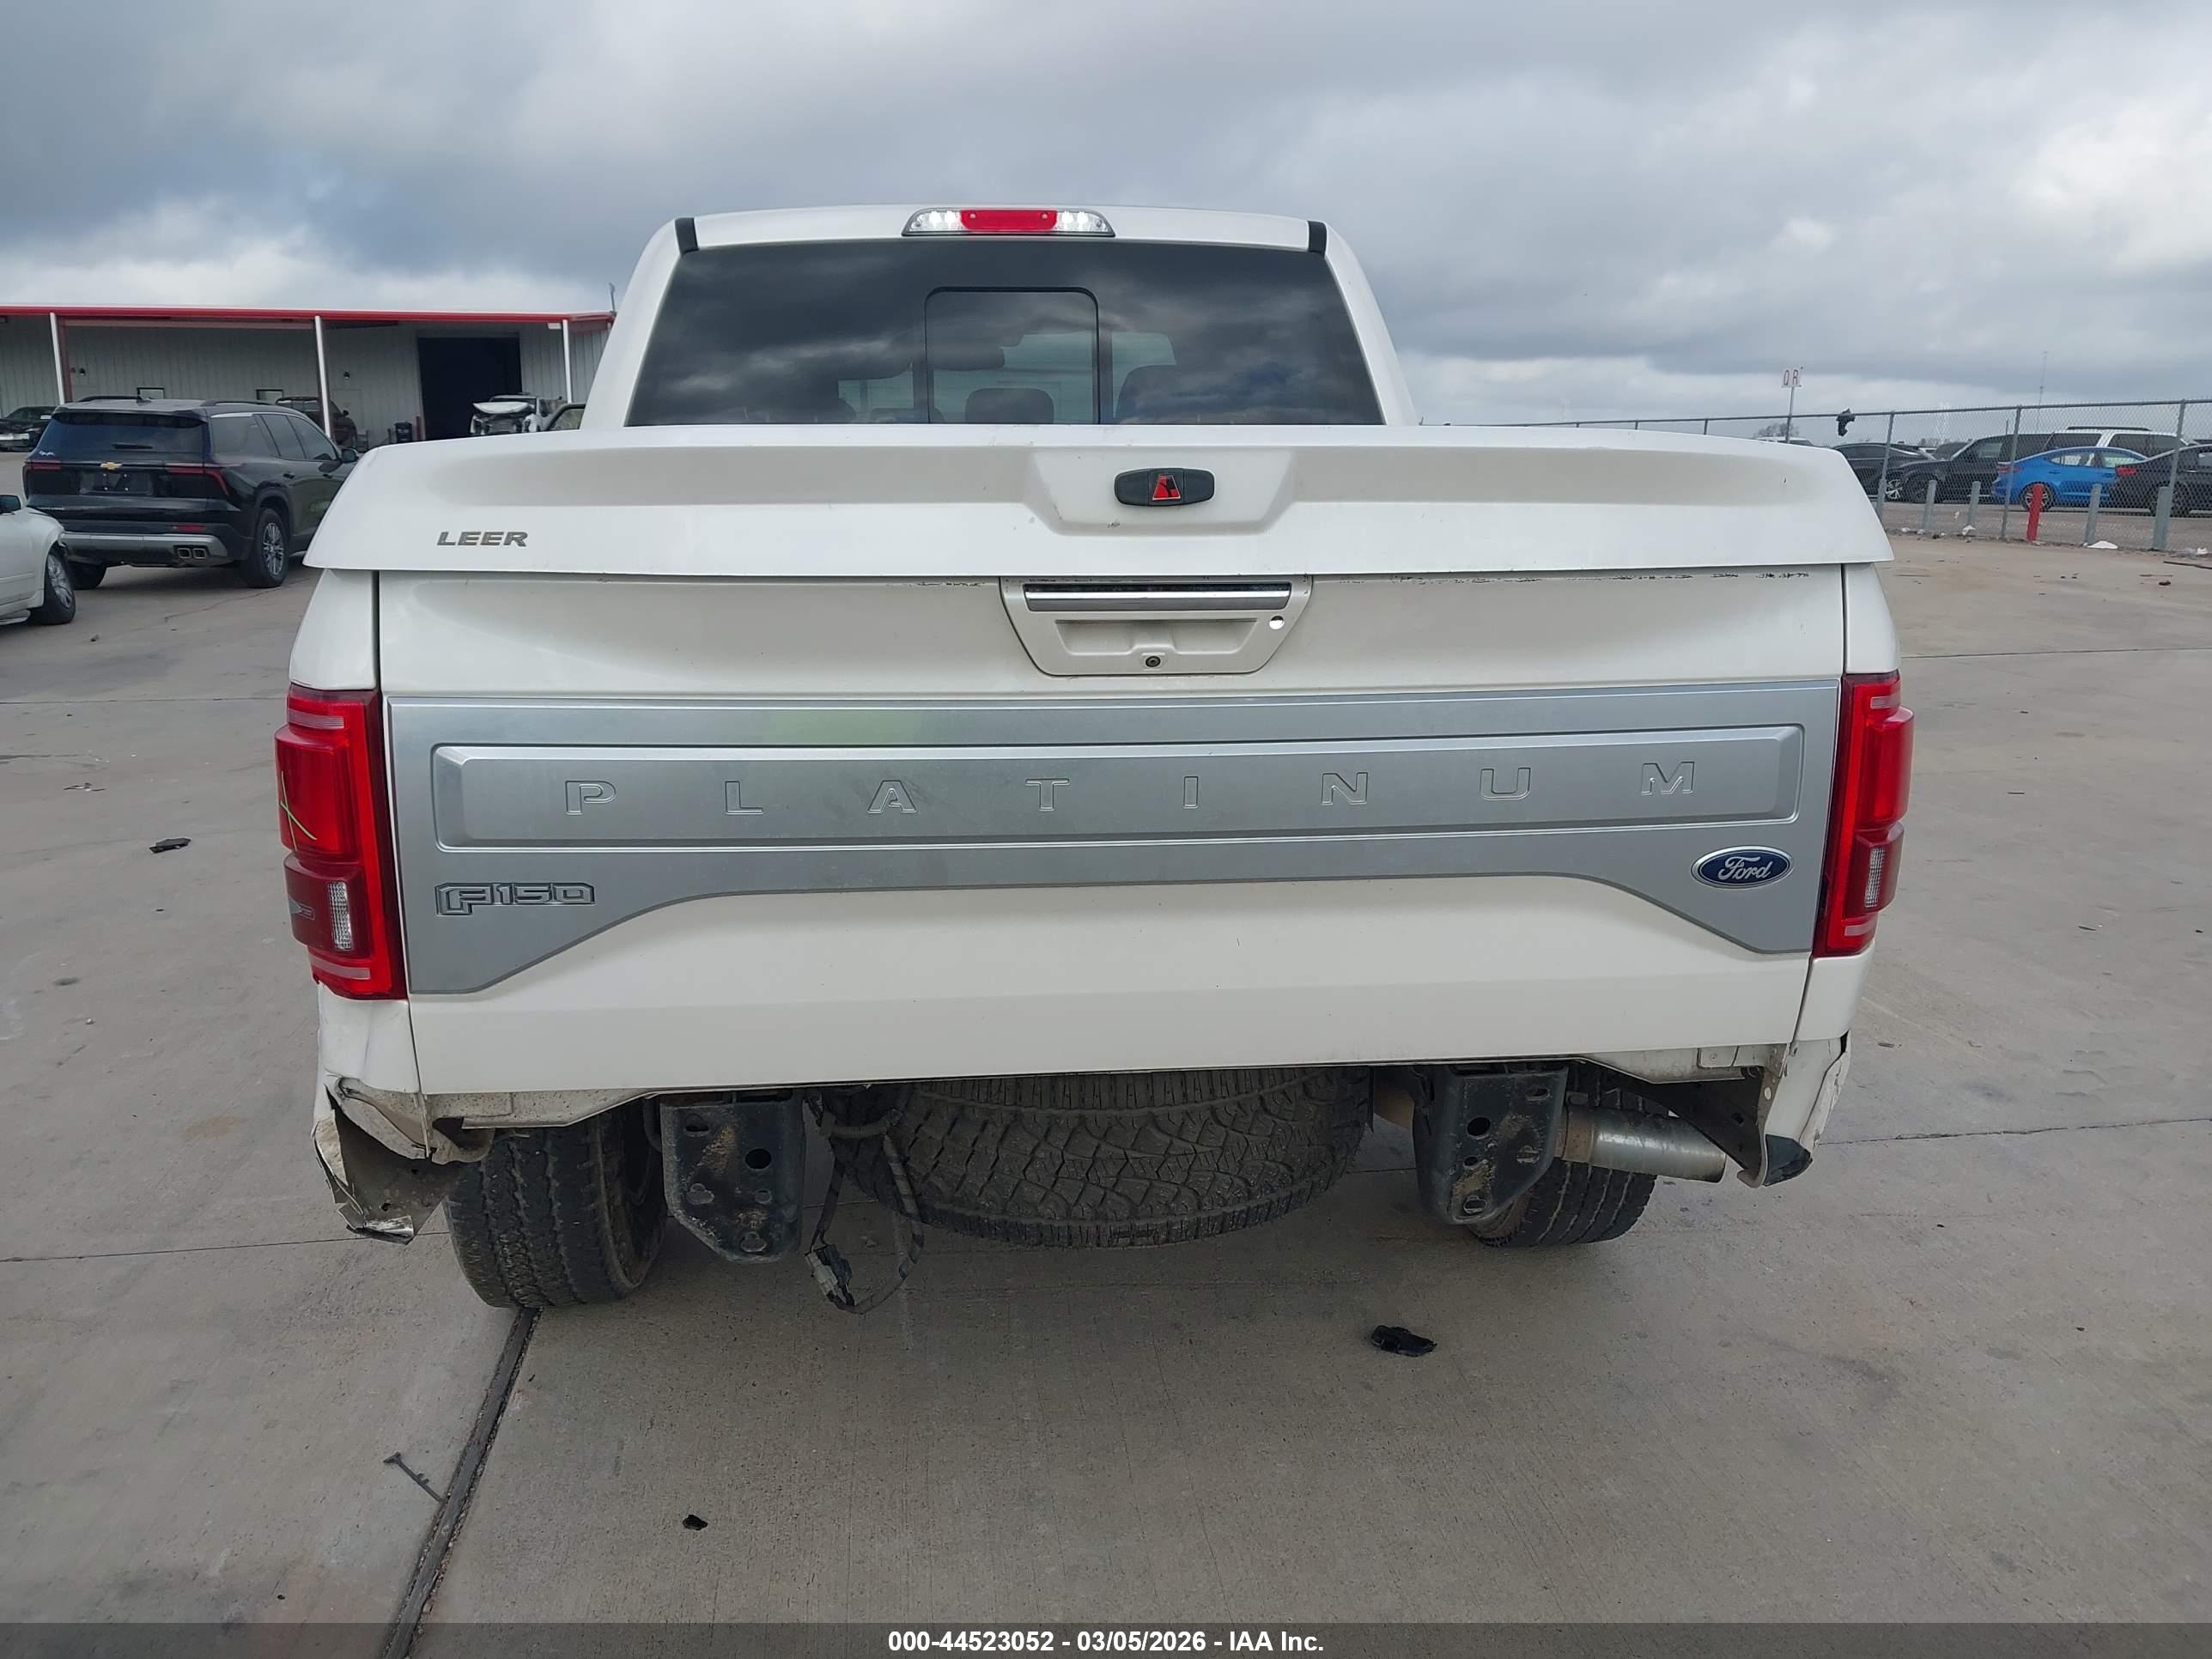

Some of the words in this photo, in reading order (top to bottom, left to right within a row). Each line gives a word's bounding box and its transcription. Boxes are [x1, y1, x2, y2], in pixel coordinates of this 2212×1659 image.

[436, 531, 529, 547] LEER
[564, 761, 1695, 816] PLATINUM
[1717, 855, 1774, 881] Ford
[434, 882, 597, 916] F150
